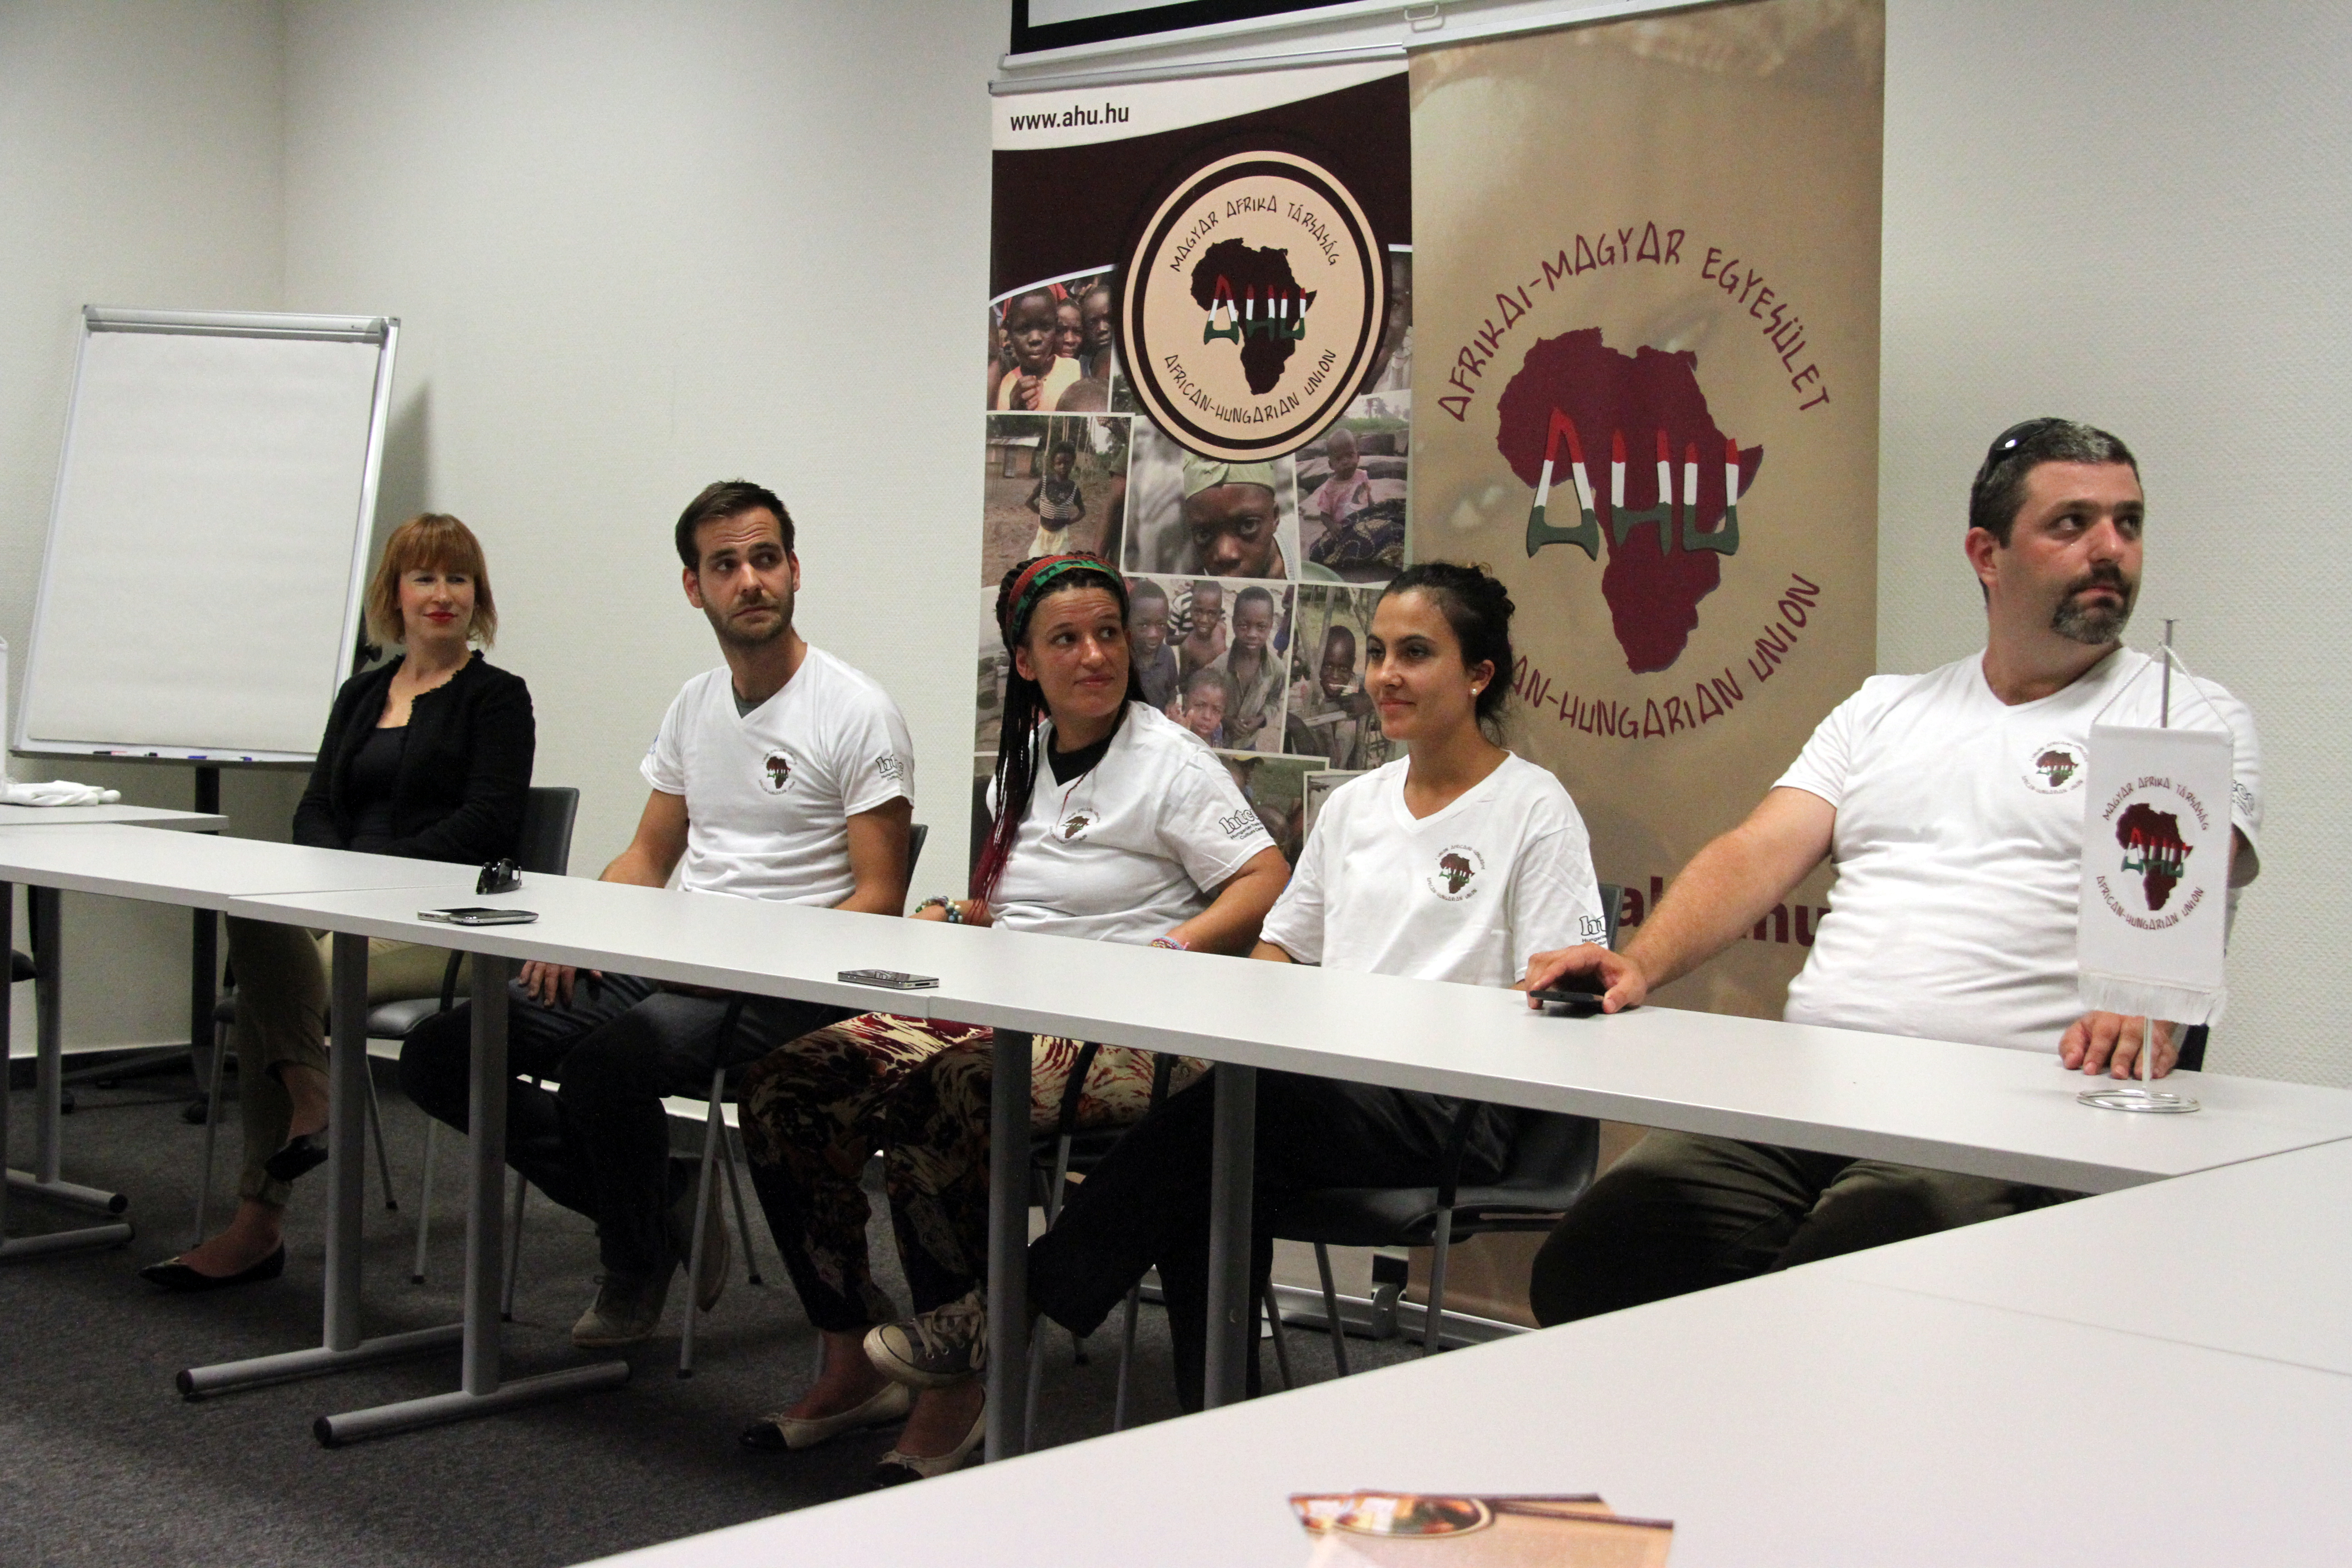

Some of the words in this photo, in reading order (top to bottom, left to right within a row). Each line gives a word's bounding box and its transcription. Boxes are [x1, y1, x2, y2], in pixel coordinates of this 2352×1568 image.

[1010, 102, 1130, 131] www.ahu.hu
[1170, 211, 1219, 272] MAGYAR
[1227, 195, 1277, 218] AFRIKA
[1287, 202, 1339, 265] TÁRSASÁG
[1204, 274, 1306, 345] AHU
[1437, 220, 1686, 422] AFRIKAI-MAGYAR
[1701, 246, 1830, 412] EGYESÜLET
[1164, 354, 1300, 424] AFRICAN-HUNGARIAN
[1304, 349, 1336, 396] UNION
[1526, 407, 1740, 562] AHU
[1748, 573, 1820, 682] UNION
[2102, 783, 2134, 820] MAGYAR
[2138, 776, 2170, 789] AFRIKA
[2121, 828, 2184, 878] AHU
[2096, 876, 2179, 930] AFRICAN-HUNGARIAN
[2181, 886, 2205, 917] UNION
